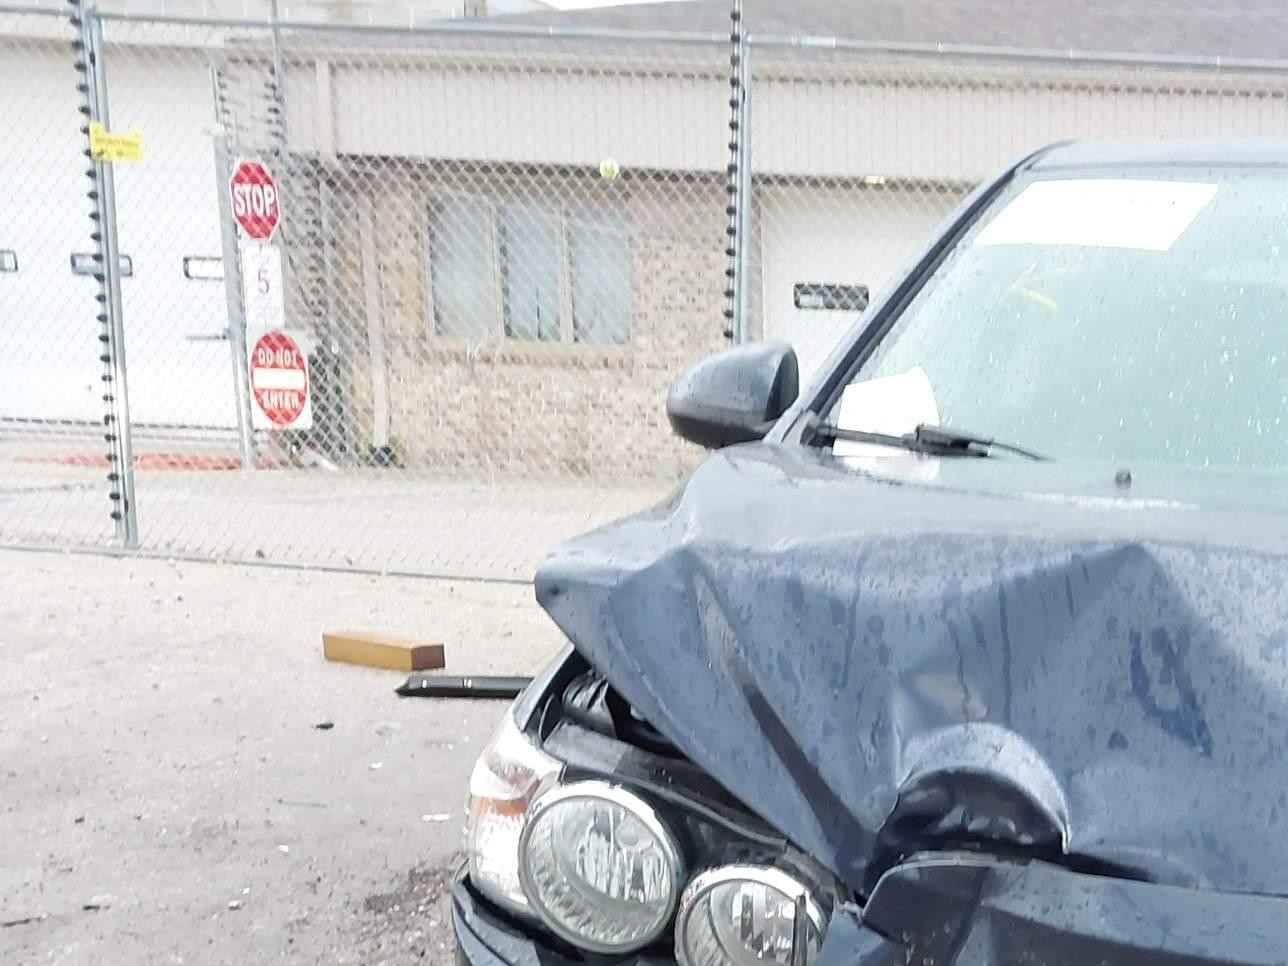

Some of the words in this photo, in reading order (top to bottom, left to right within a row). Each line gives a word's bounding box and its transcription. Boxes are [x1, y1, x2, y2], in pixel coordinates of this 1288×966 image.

[233, 182, 275, 217] STOP
[257, 268, 270, 294] 5
[258, 346, 273, 366] DO
